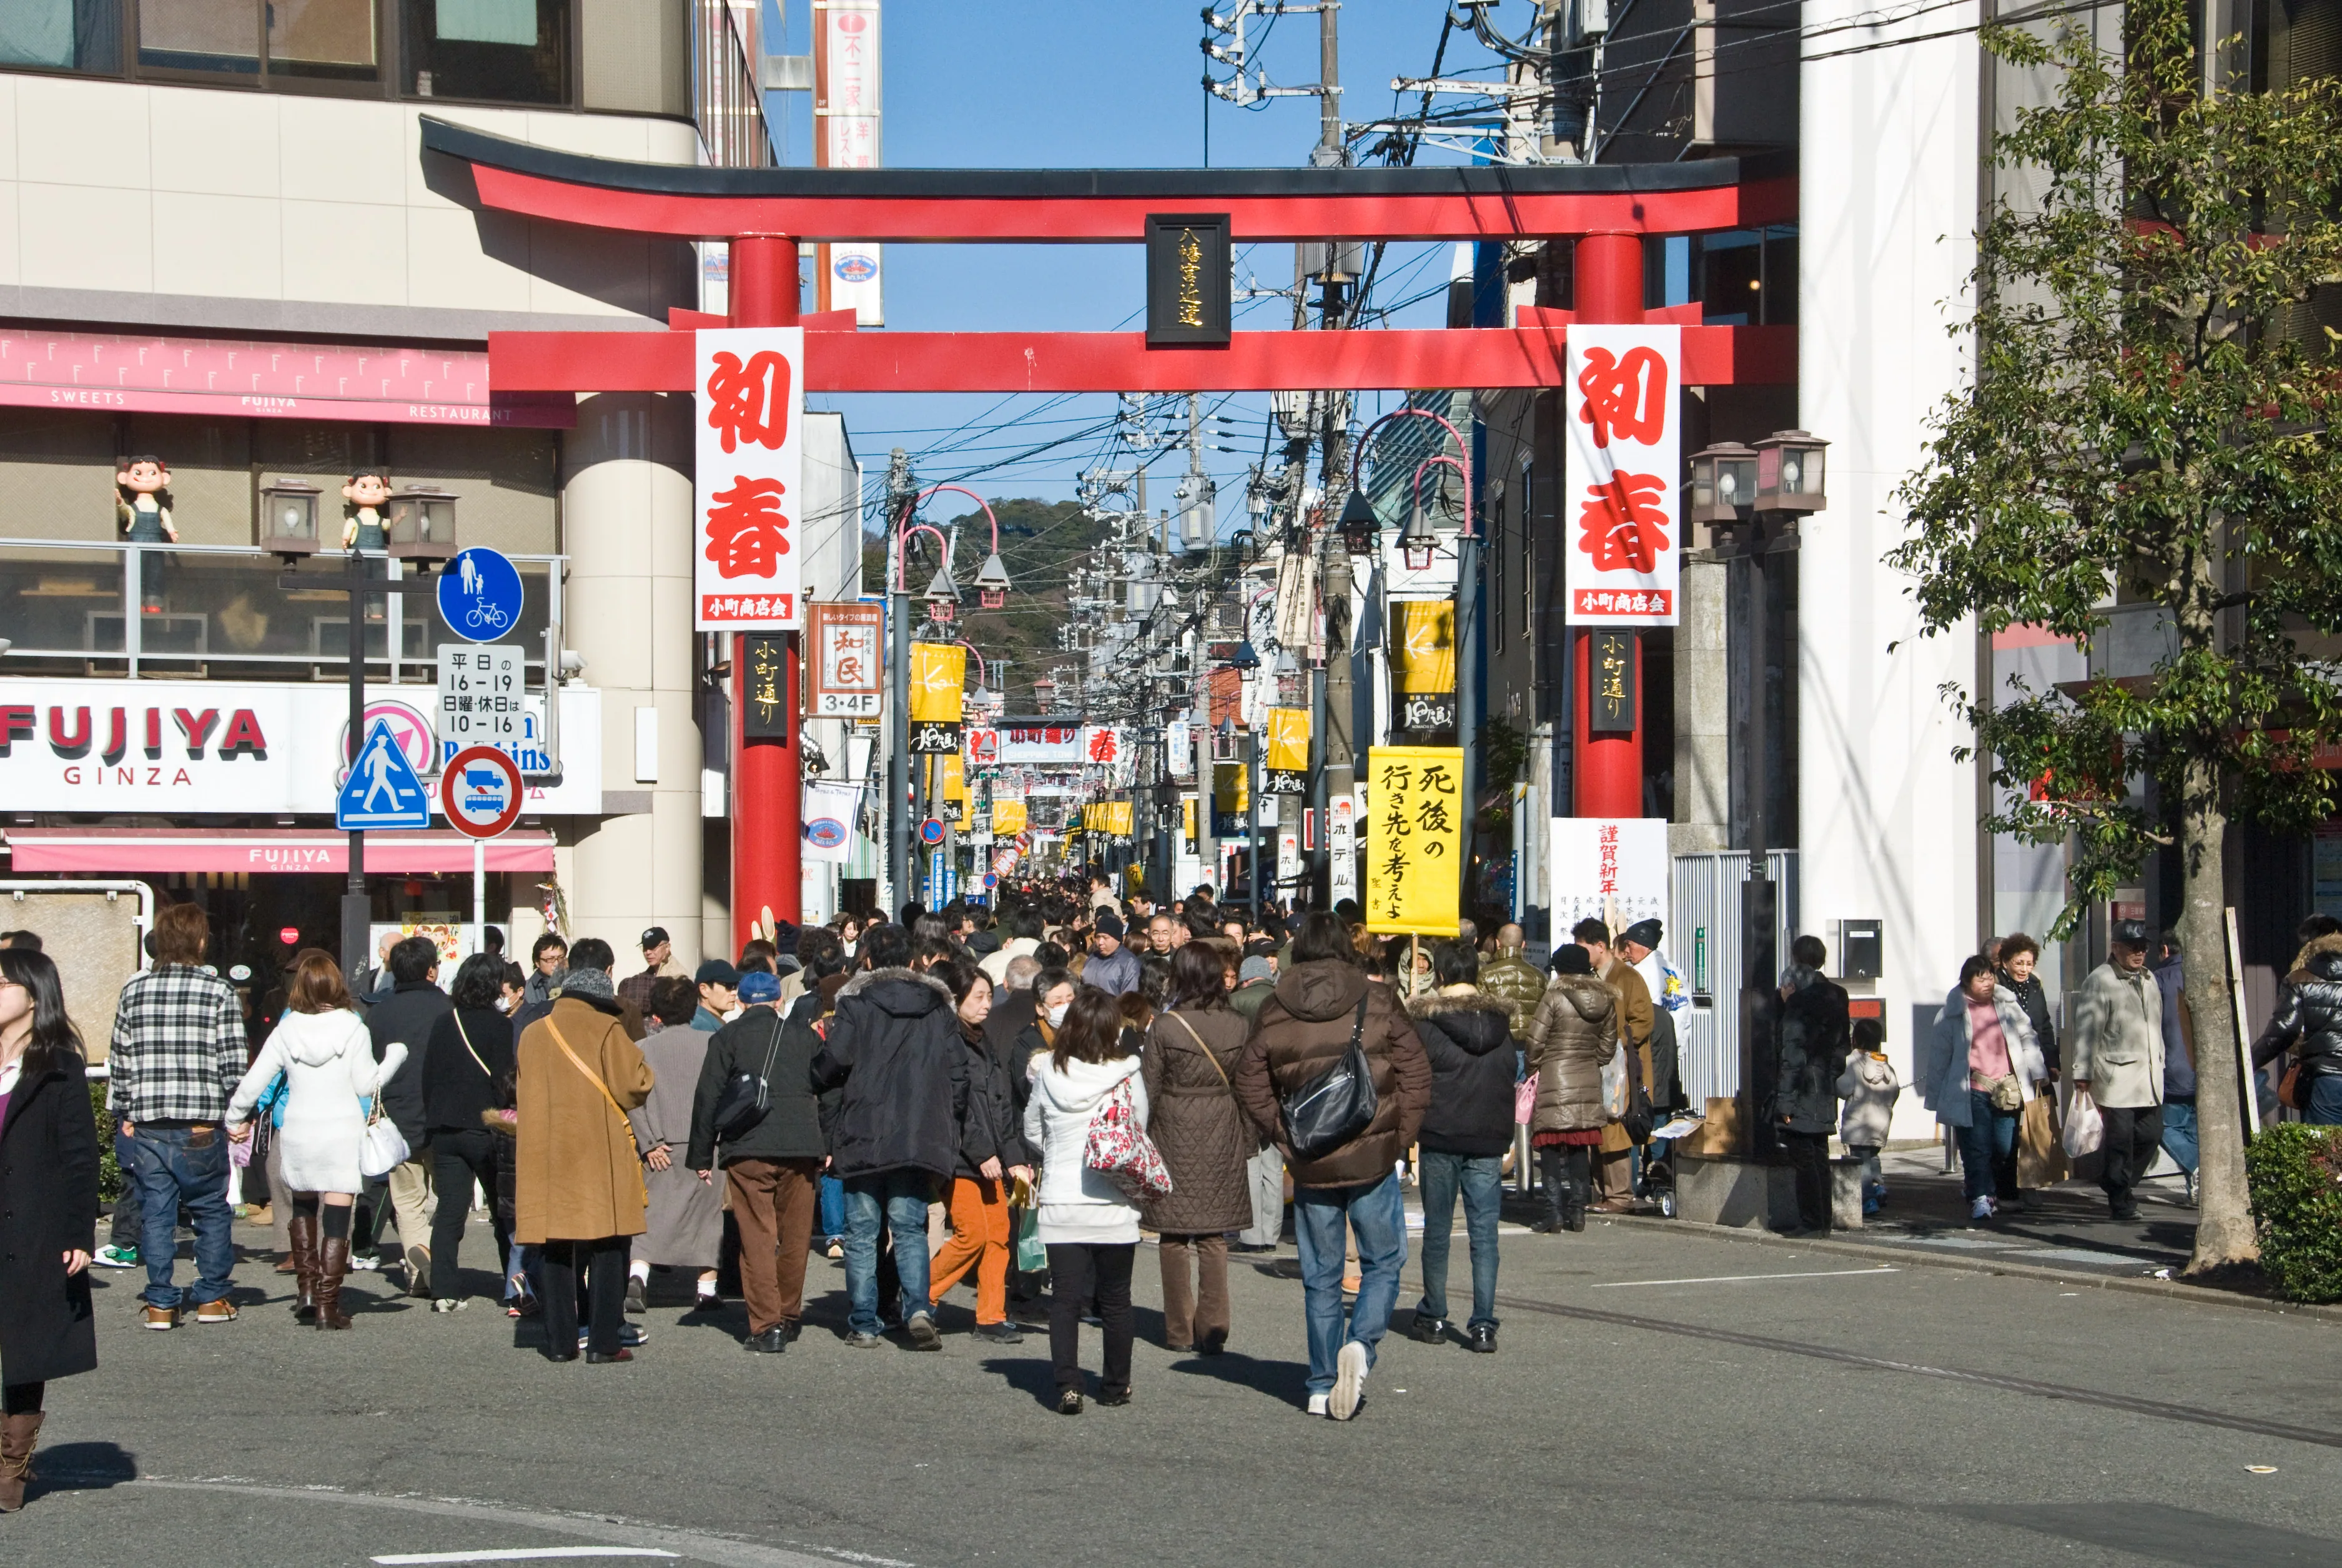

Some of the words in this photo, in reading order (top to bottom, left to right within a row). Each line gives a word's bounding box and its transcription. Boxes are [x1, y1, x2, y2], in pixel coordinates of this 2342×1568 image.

[845, 36, 861, 107] 不二家
[51, 390, 124, 405] SWEETS
[242, 396, 296, 408] FUJIYA
[410, 405, 511, 420] RESTAURANT
[705, 350, 791, 579] 初春
[1578, 346, 1669, 573] 初春
[708, 597, 788, 618] 小町商店会
[1581, 593, 1667, 613] 小町商店会
[452, 653, 511, 671] 平日の
[754, 641, 779, 725] 小町通り
[834, 630, 864, 684] 和民
[1601, 636, 1626, 719] 小町通り
[0, 705, 267, 758] FUJIYA
[1008, 751, 1049, 759] SHOPPING
[1053, 751, 1076, 759] TOWN
[64, 767, 192, 786] GINZA
[1415, 765, 1456, 859] 死後の
[250, 849, 330, 864] FUJIYA
[1333, 823, 1348, 885] ホテル
[1381, 765, 1412, 919] 行き先を考えよ
[1599, 824, 1619, 895] 謹賀新年
[1370, 877, 1381, 910] 聖書
